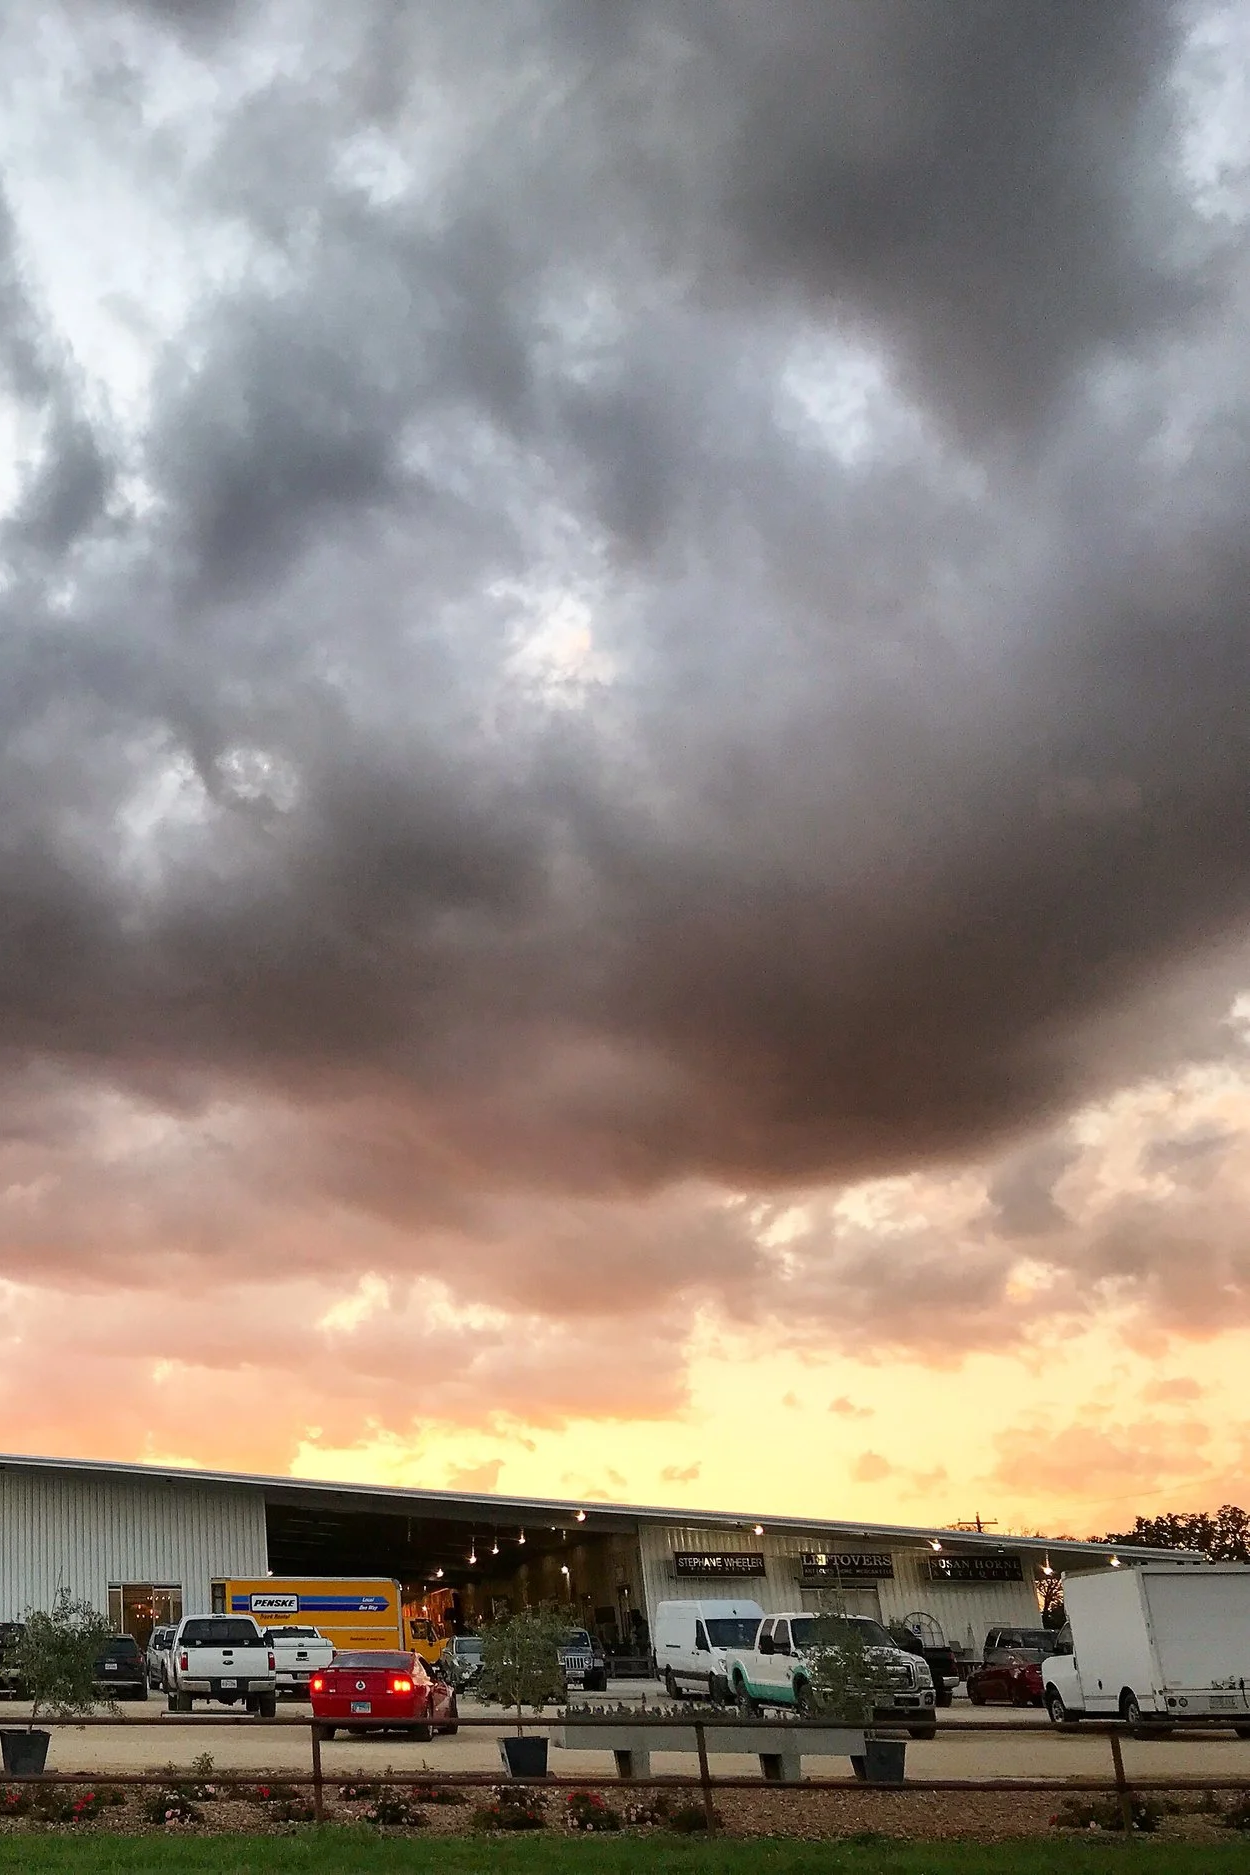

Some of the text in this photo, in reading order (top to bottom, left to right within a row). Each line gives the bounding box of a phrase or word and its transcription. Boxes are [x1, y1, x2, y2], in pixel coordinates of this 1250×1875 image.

[678, 1557, 763, 1568] STEPHANE WHEELER
[801, 1554, 892, 1566] LEFTOVERS
[930, 1559, 1020, 1569] SUSAN HORNE
[253, 1599, 296, 1607] PENSKE
